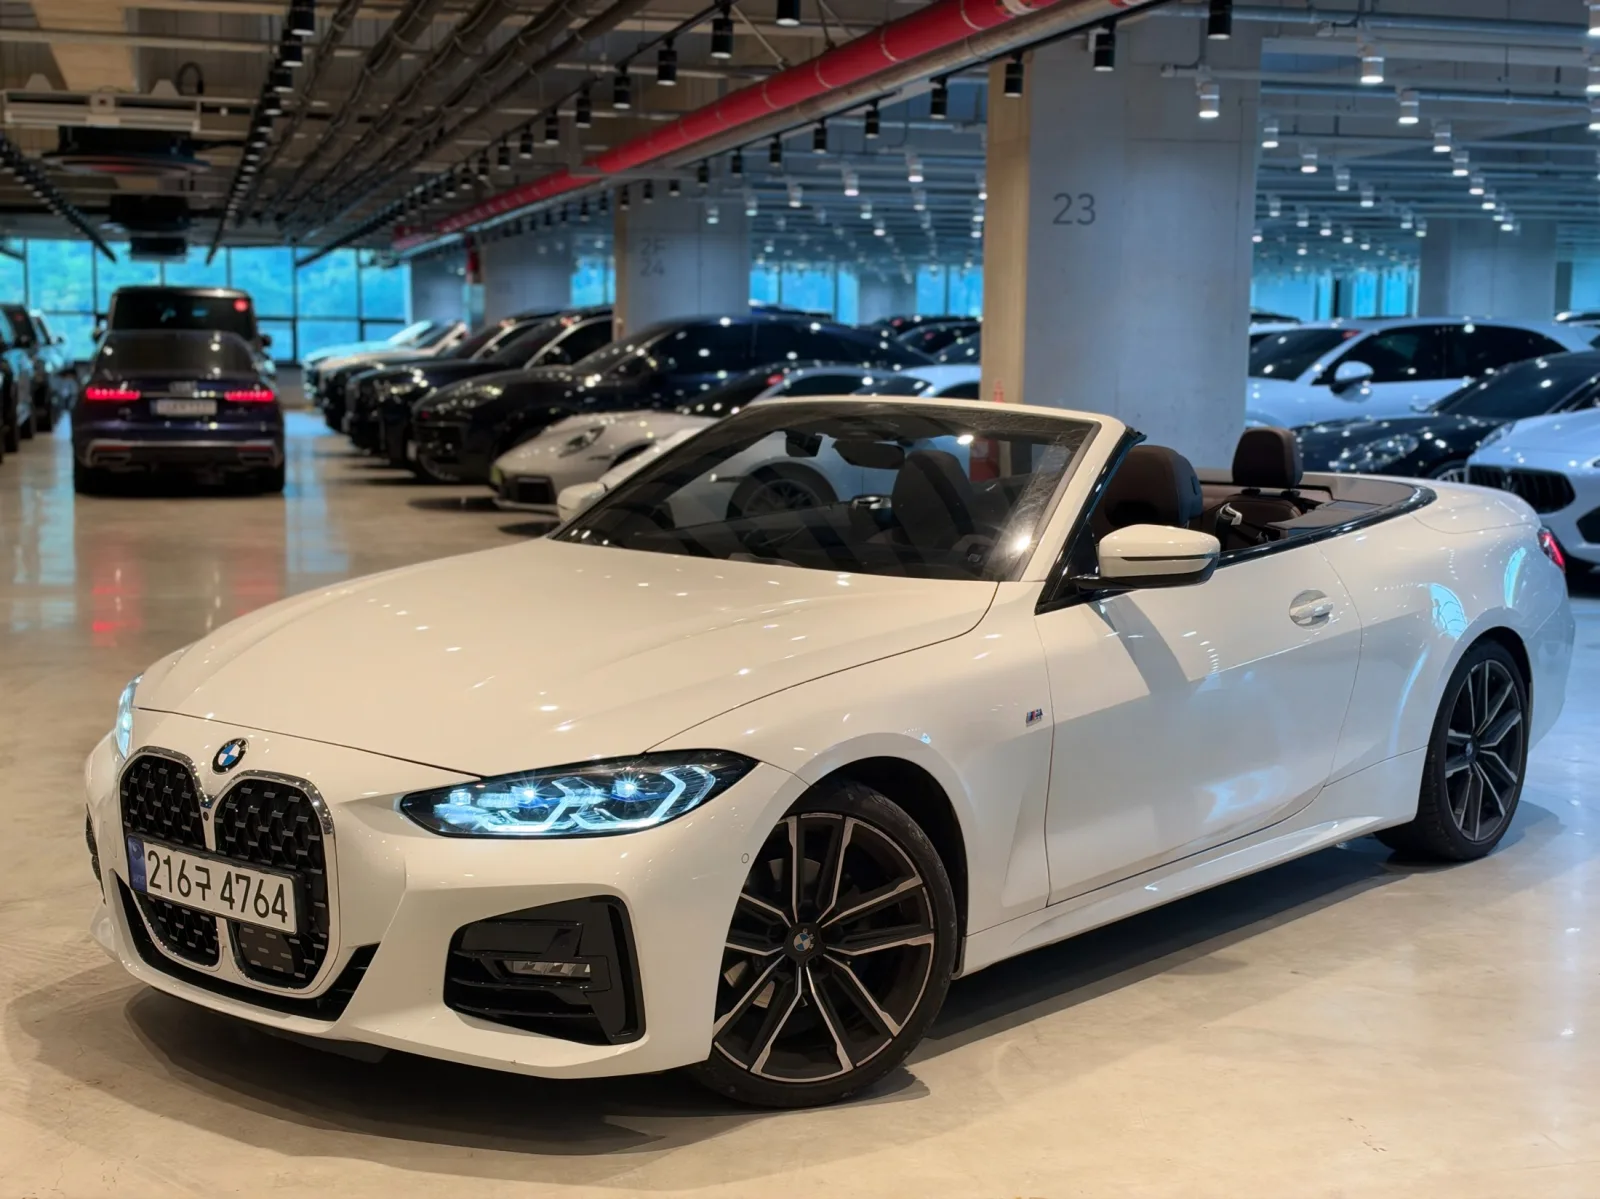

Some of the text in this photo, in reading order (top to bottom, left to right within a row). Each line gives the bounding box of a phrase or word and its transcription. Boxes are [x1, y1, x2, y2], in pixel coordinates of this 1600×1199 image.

[1053, 192, 1096, 226] 23
[640, 258, 665, 278] 24
[147, 850, 288, 924] 216구 4764
